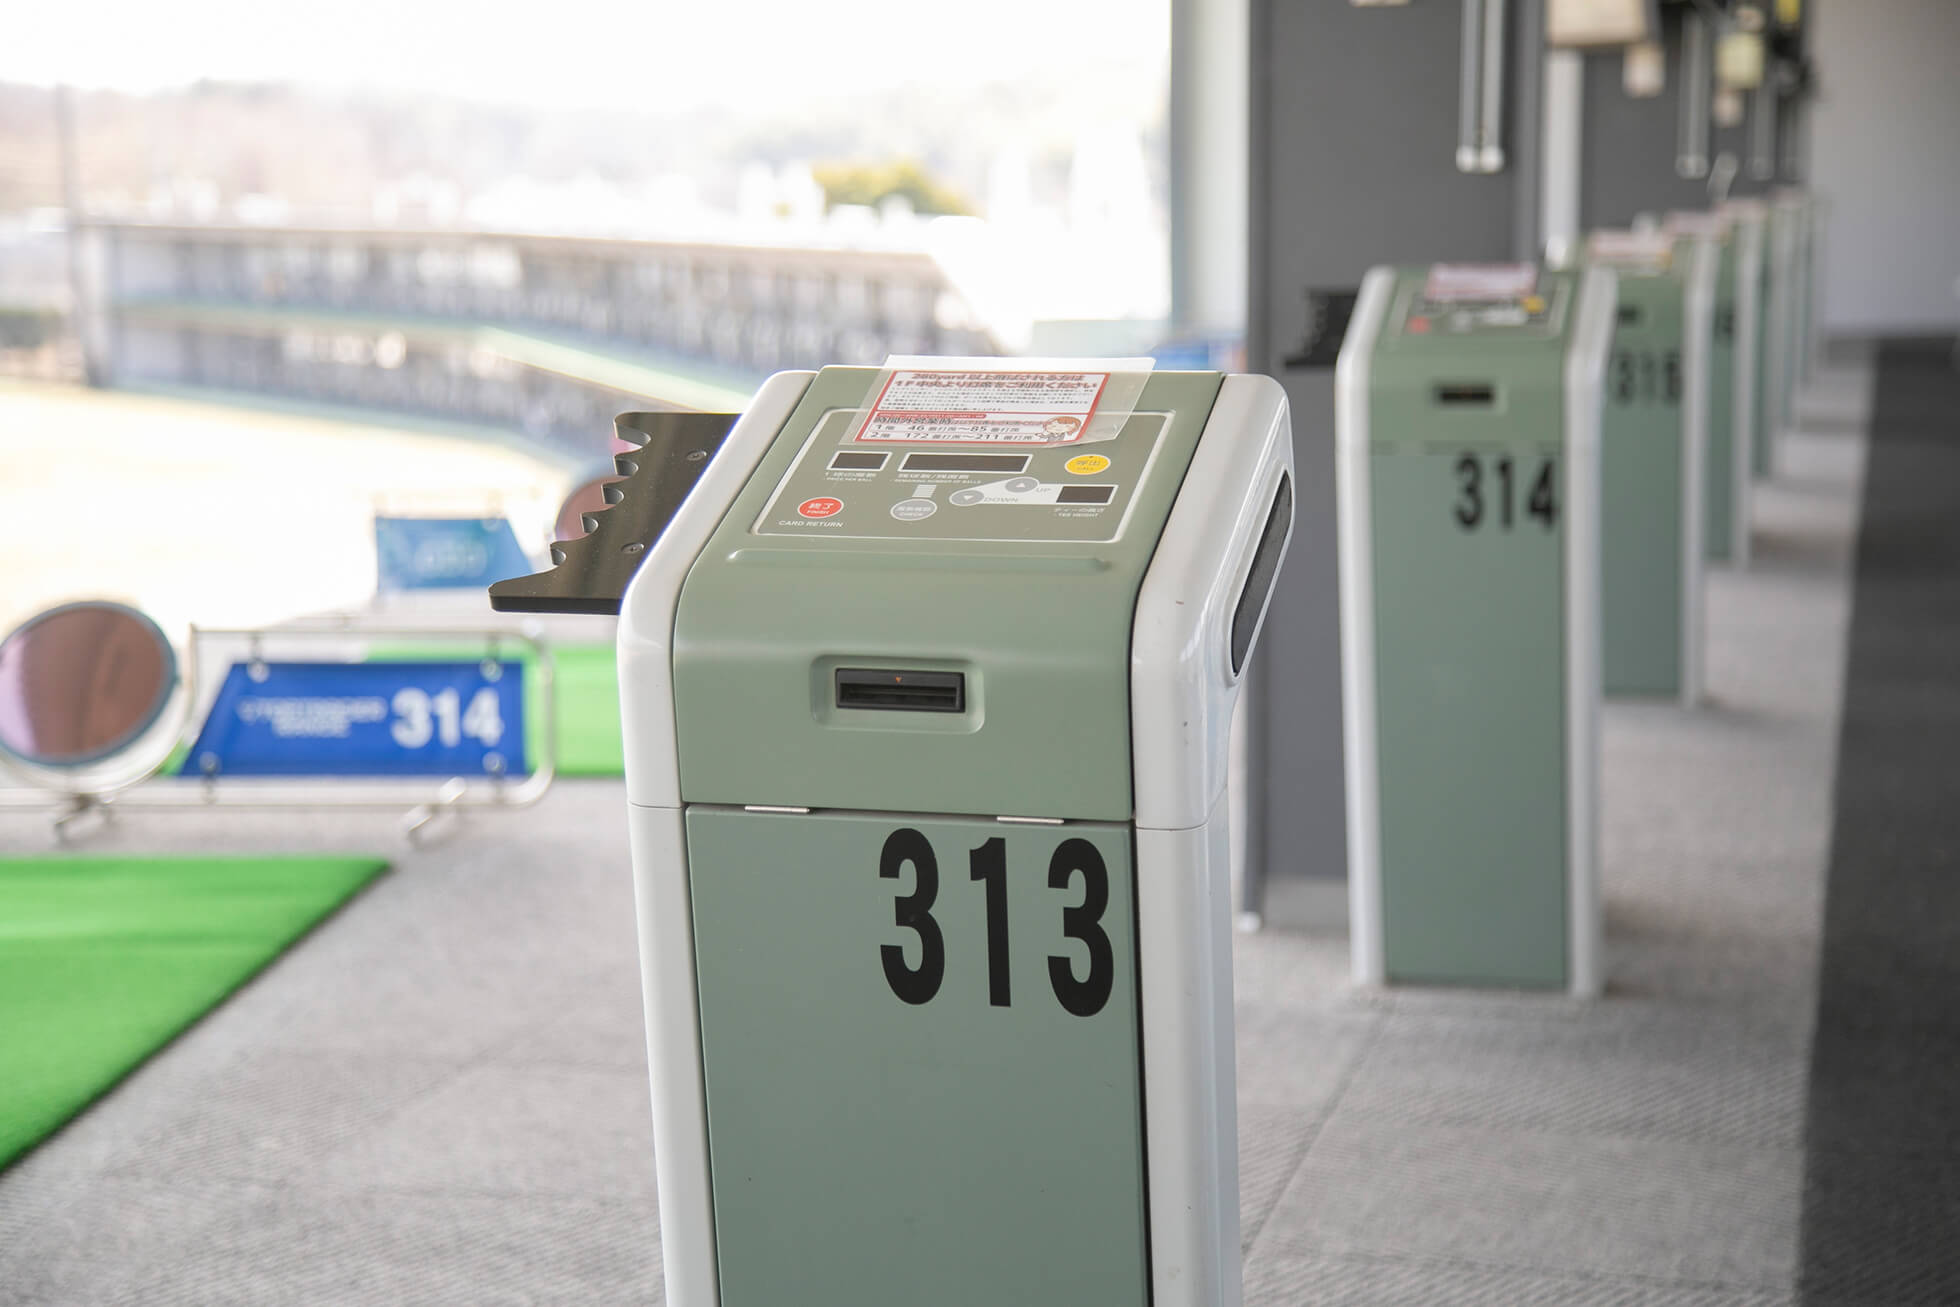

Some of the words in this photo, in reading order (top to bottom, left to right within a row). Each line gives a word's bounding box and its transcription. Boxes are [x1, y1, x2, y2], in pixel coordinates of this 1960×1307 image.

[1454, 455, 1560, 532] 314
[391, 687, 505, 749] 314
[879, 827, 1114, 1018] 313
